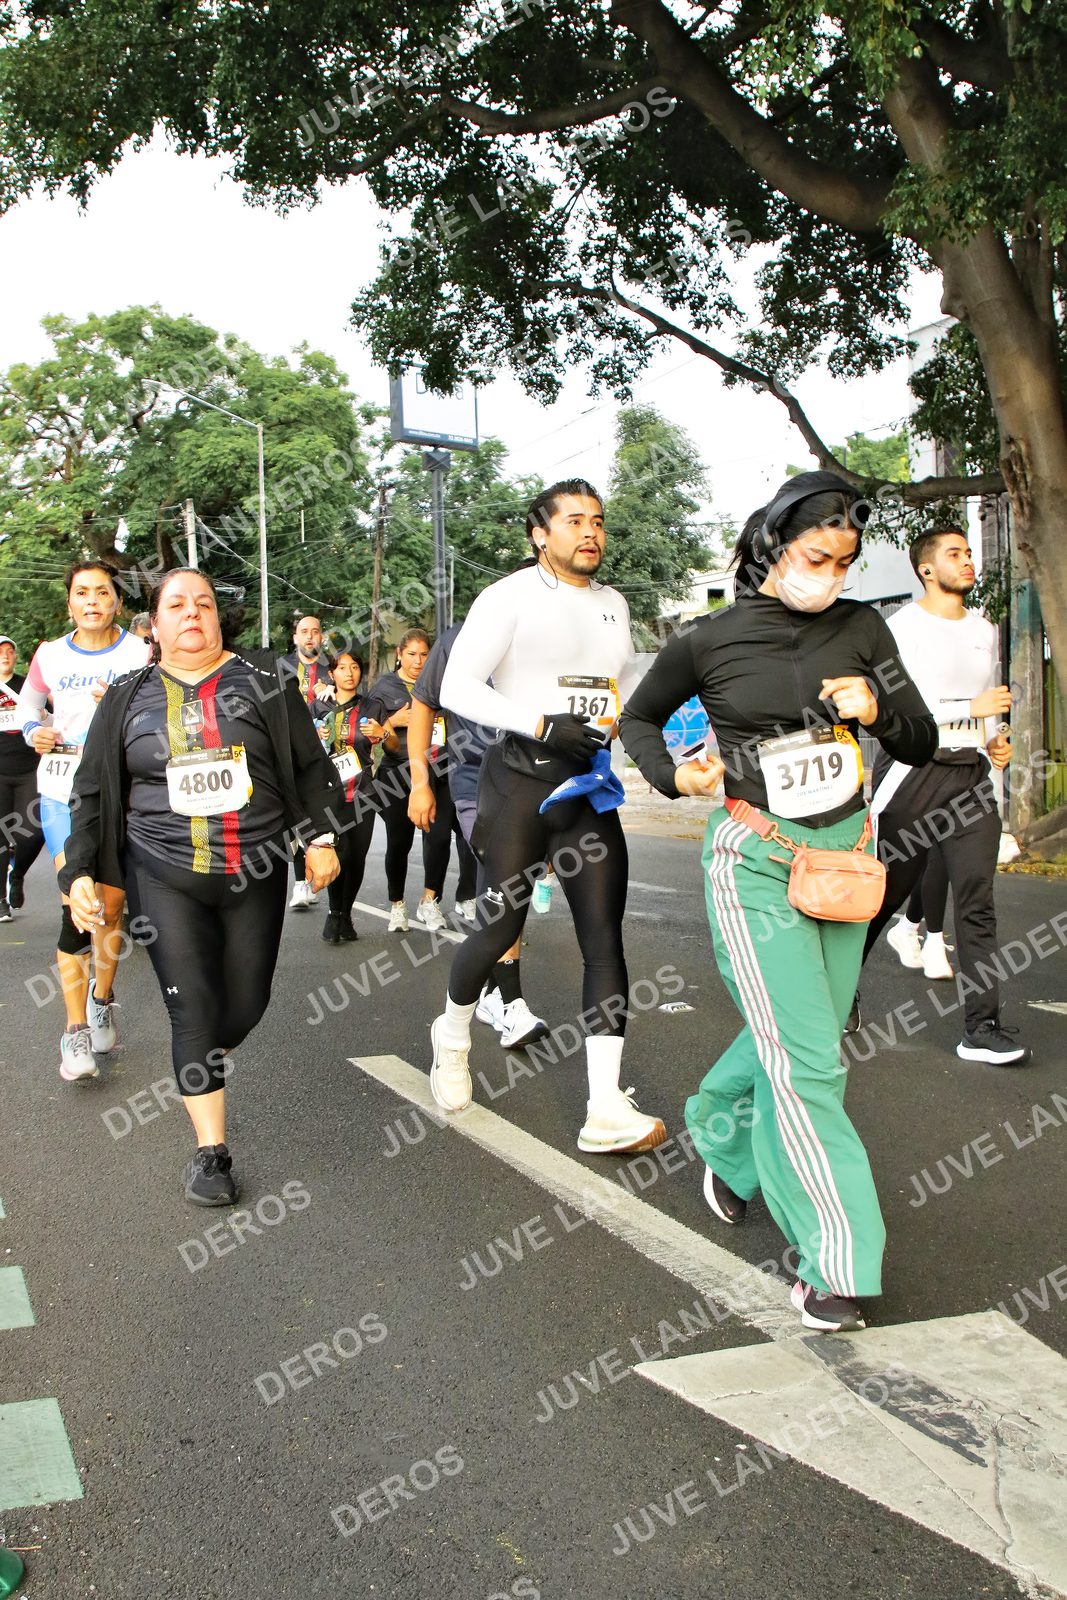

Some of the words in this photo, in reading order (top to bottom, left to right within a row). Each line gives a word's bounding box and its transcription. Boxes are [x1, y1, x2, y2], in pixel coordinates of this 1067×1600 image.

[567, 695, 609, 717] 1367
[179, 769, 233, 795] 4800
[777, 752, 843, 791] 3719
